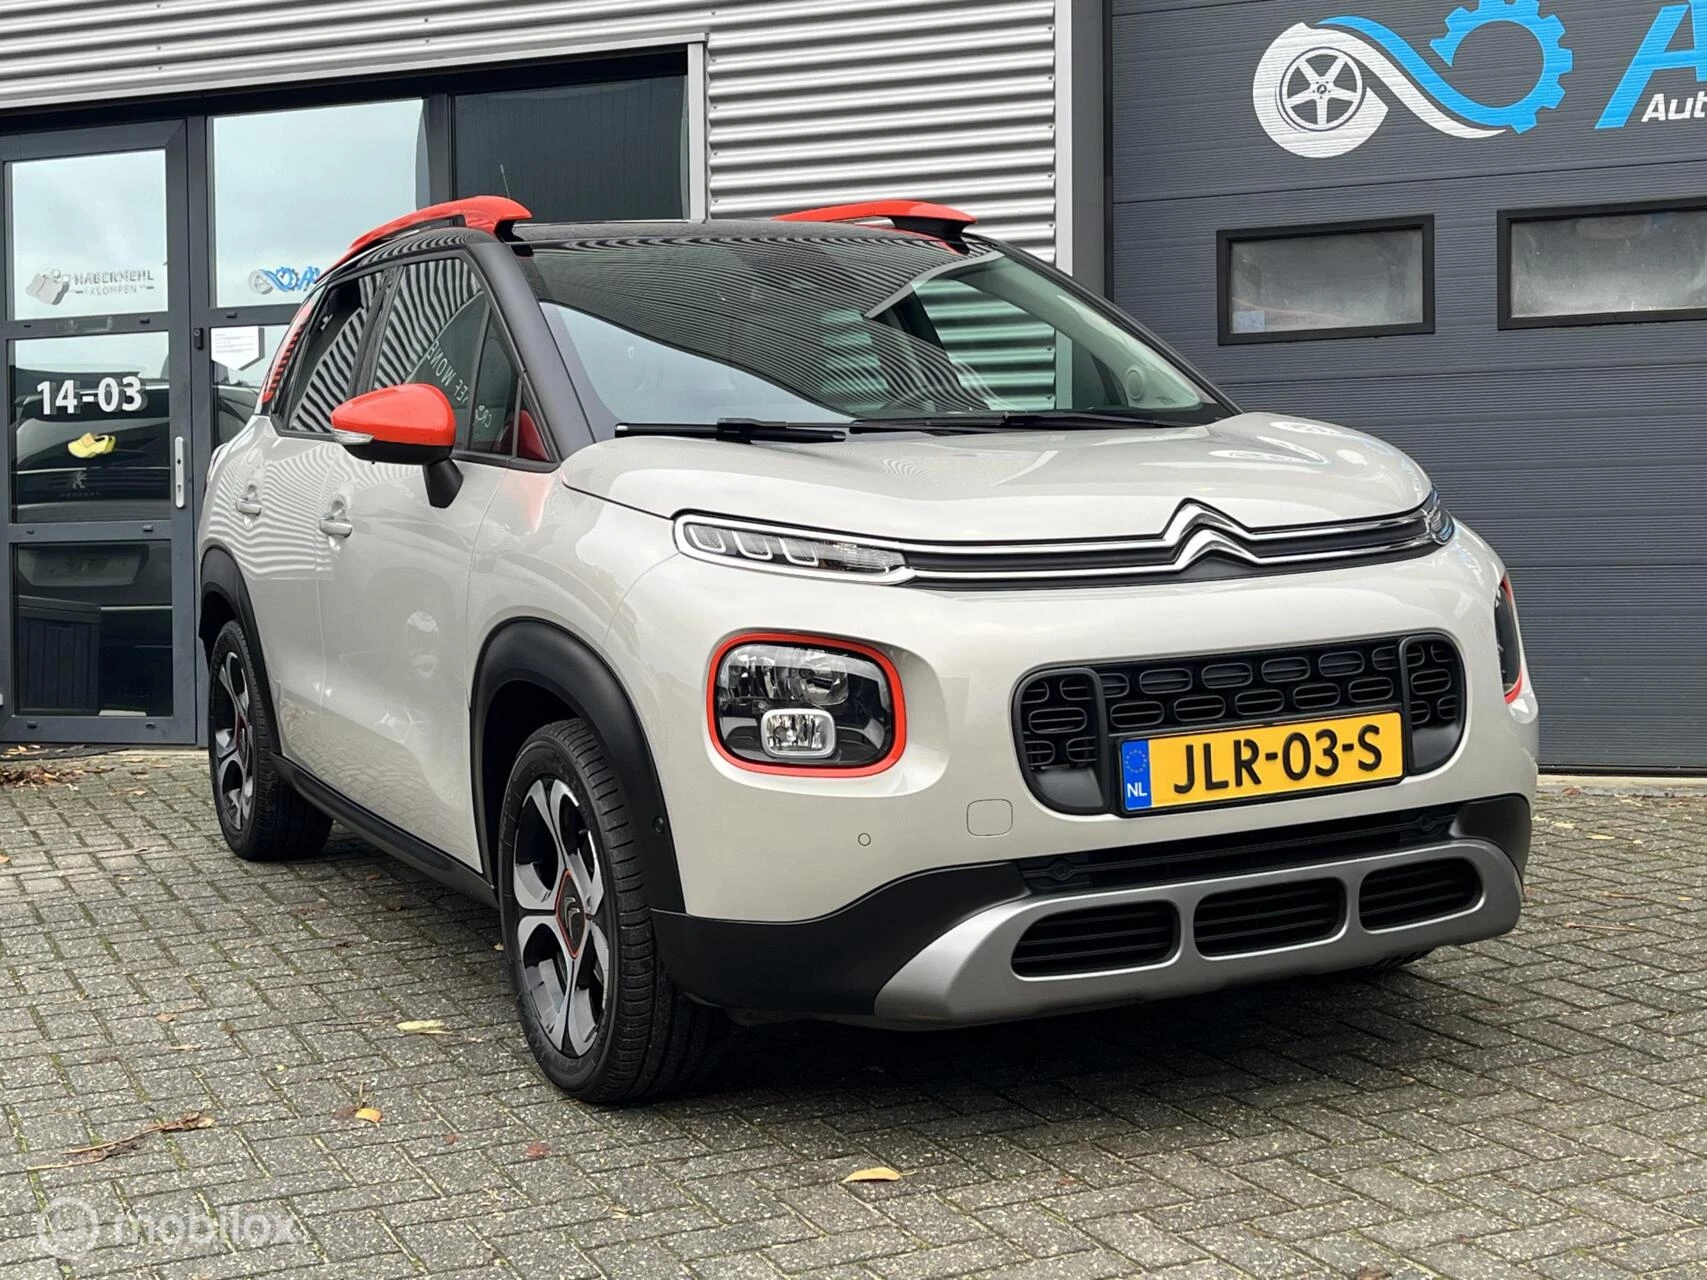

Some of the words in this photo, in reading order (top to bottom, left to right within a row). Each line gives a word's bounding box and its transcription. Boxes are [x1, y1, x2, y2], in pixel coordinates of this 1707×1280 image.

[71, 269, 155, 286] HABERMEHL
[87, 284, 137, 297] KLOMPEN
[36, 375, 146, 416] 14-03
[1173, 724, 1383, 795] JLR-03-S
[1127, 782, 1148, 798] NL
